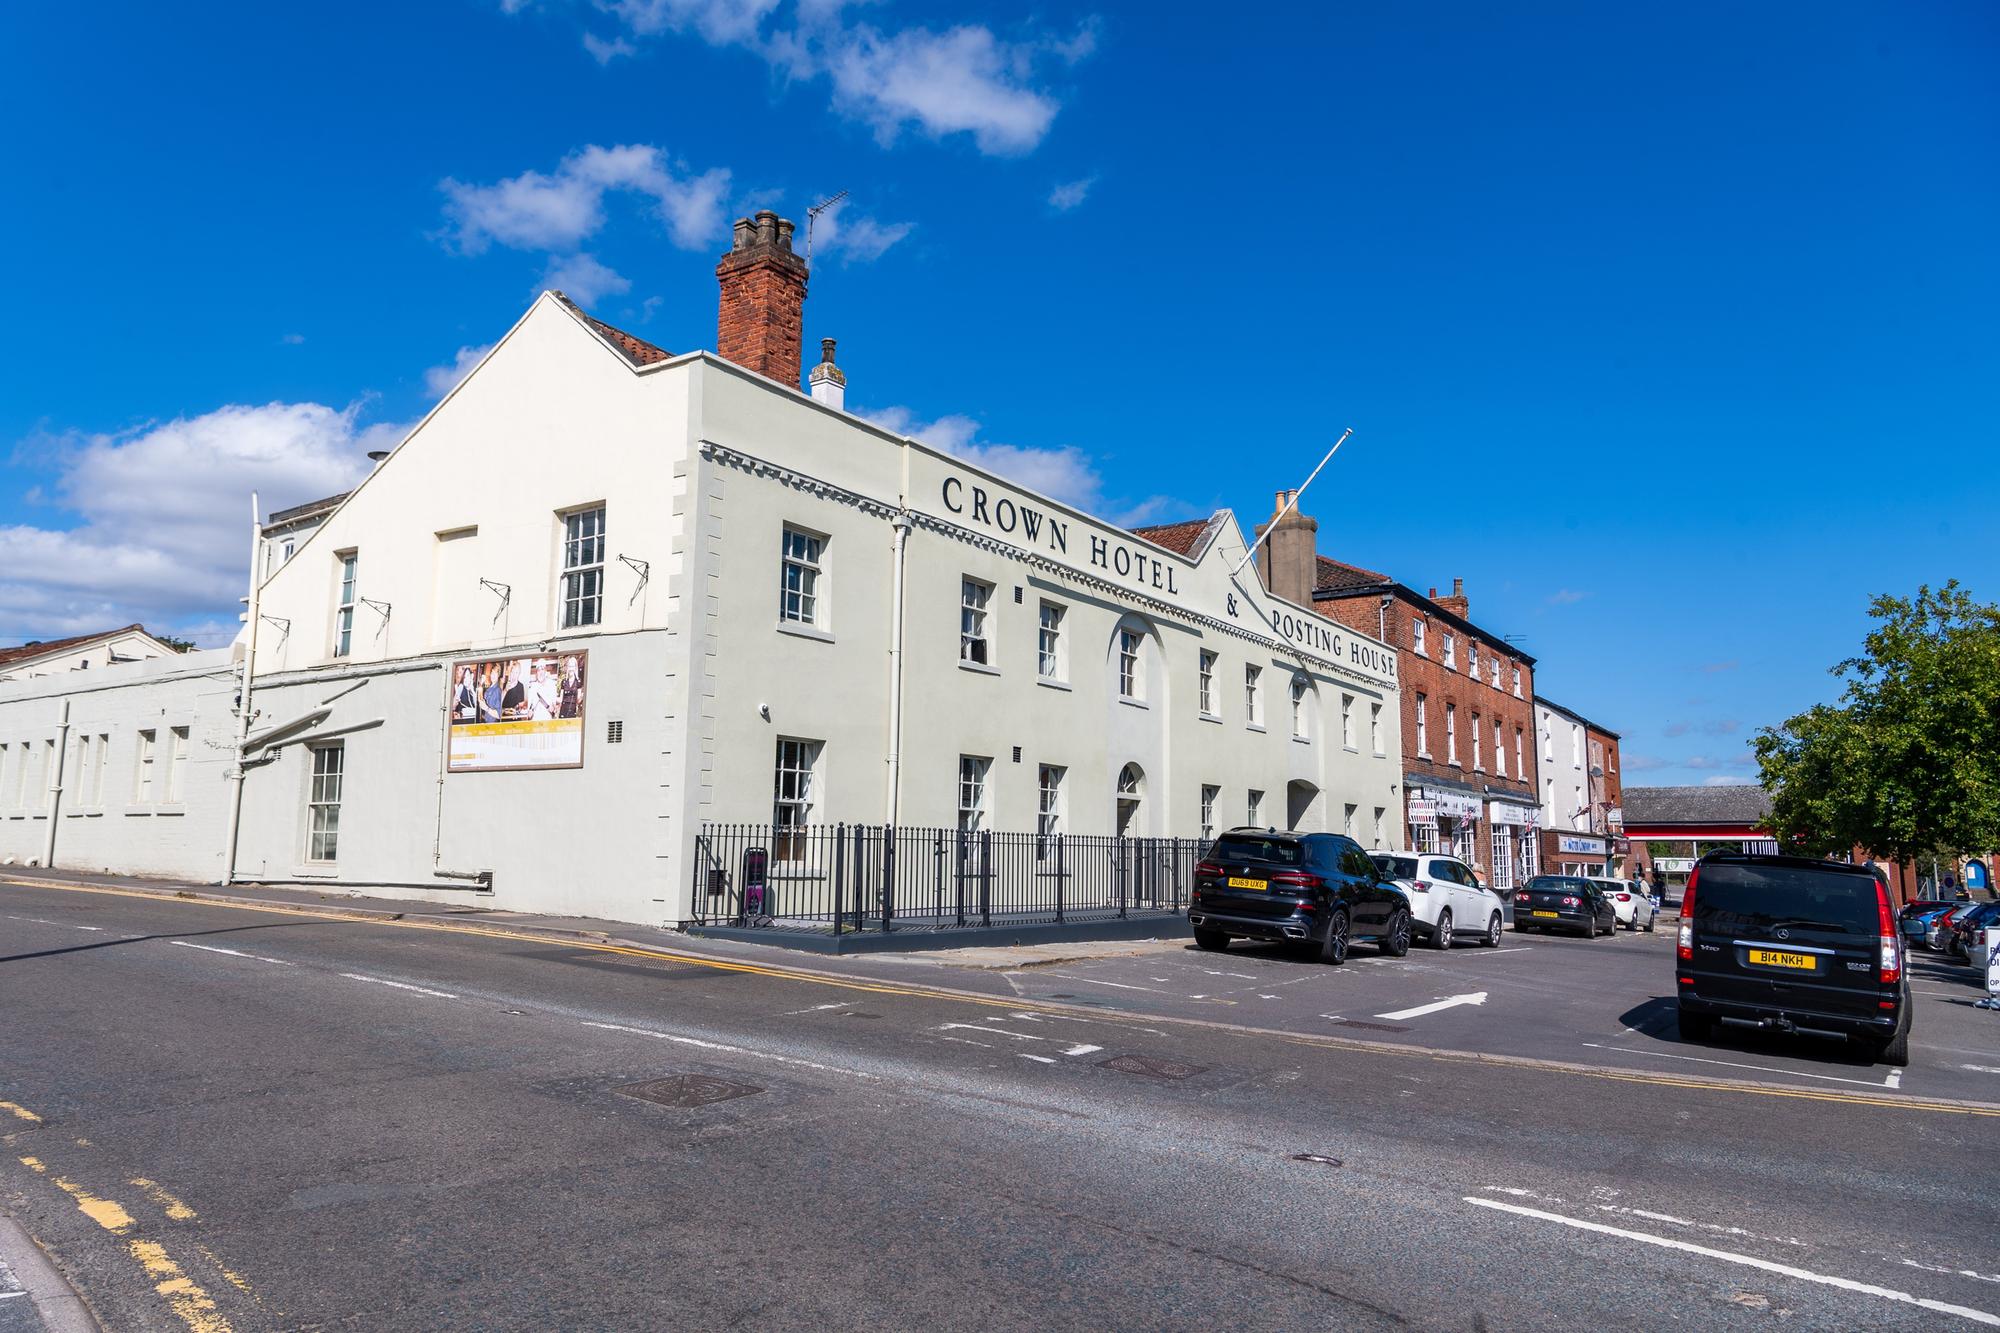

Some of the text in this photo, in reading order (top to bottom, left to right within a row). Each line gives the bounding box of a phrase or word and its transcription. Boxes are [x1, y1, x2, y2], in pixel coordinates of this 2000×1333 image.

[942, 477, 1395, 676] CROWN HOTEL & POSTING HOUSE
[1781, 954, 1803, 966] NKH
